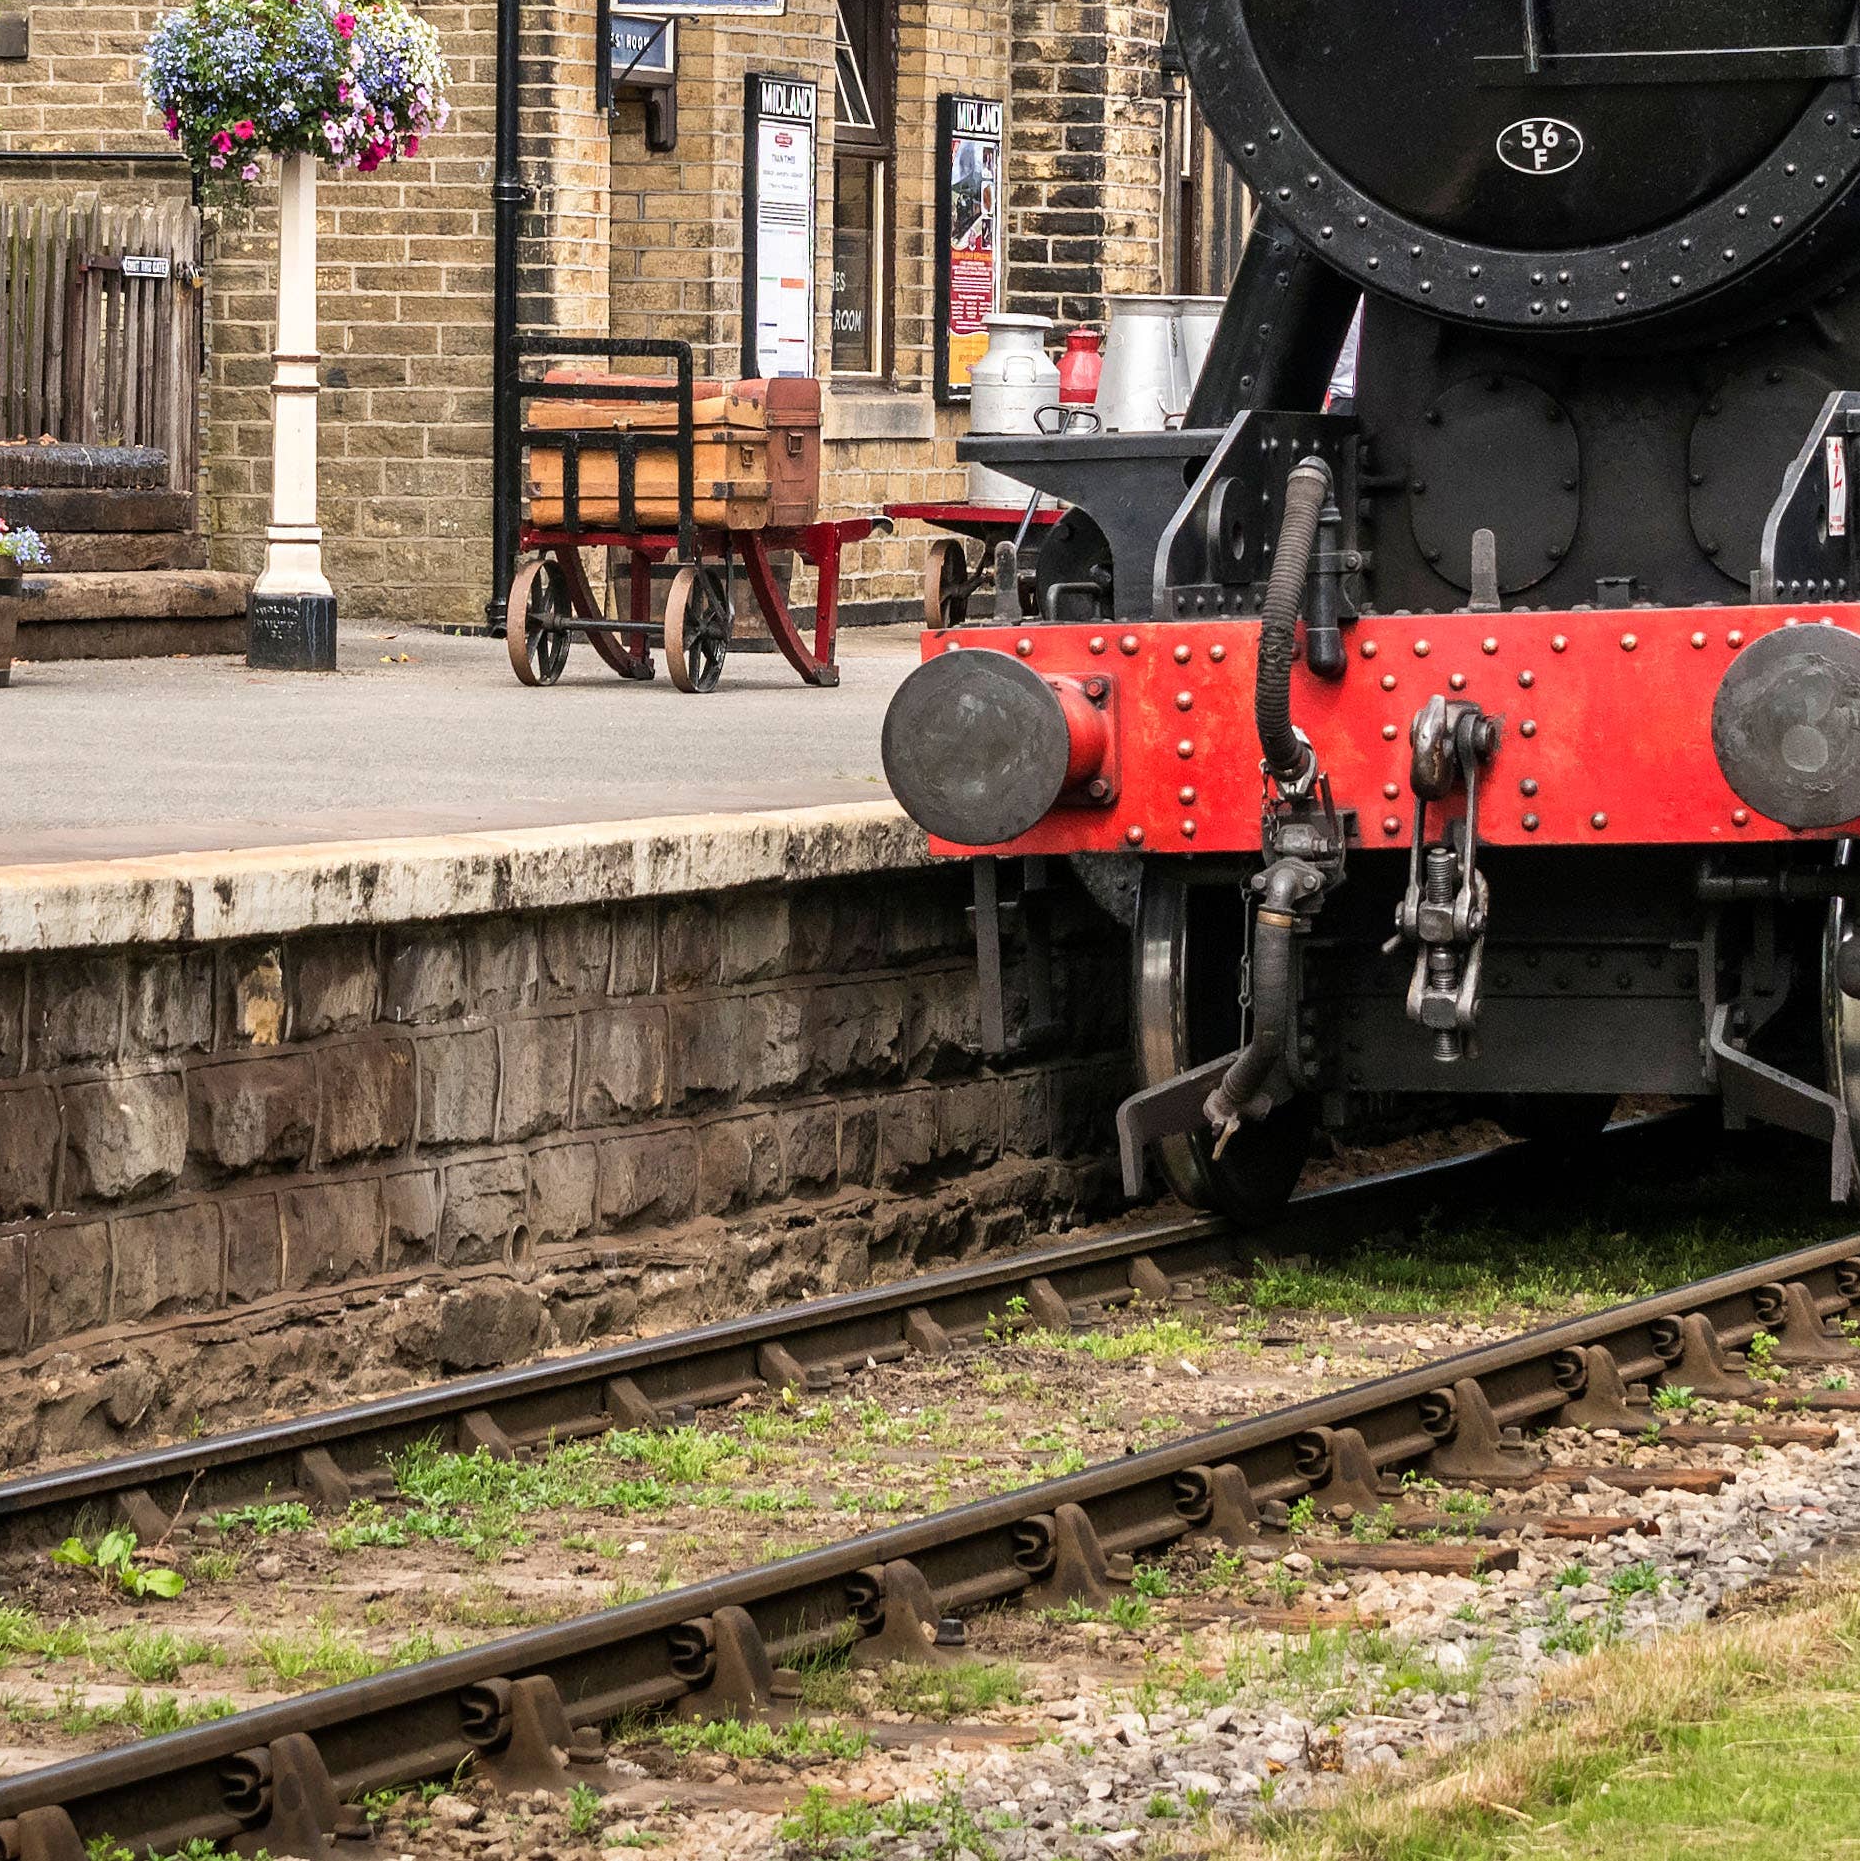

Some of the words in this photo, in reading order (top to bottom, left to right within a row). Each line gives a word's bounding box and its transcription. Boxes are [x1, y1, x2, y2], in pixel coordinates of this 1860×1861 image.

[761, 82, 812, 118] MIDLAND
[957, 102, 1000, 133] MIDLAND
[1521, 122, 1559, 149] 56
[1534, 148, 1548, 170] F
[833, 309, 862, 332] ROOM
